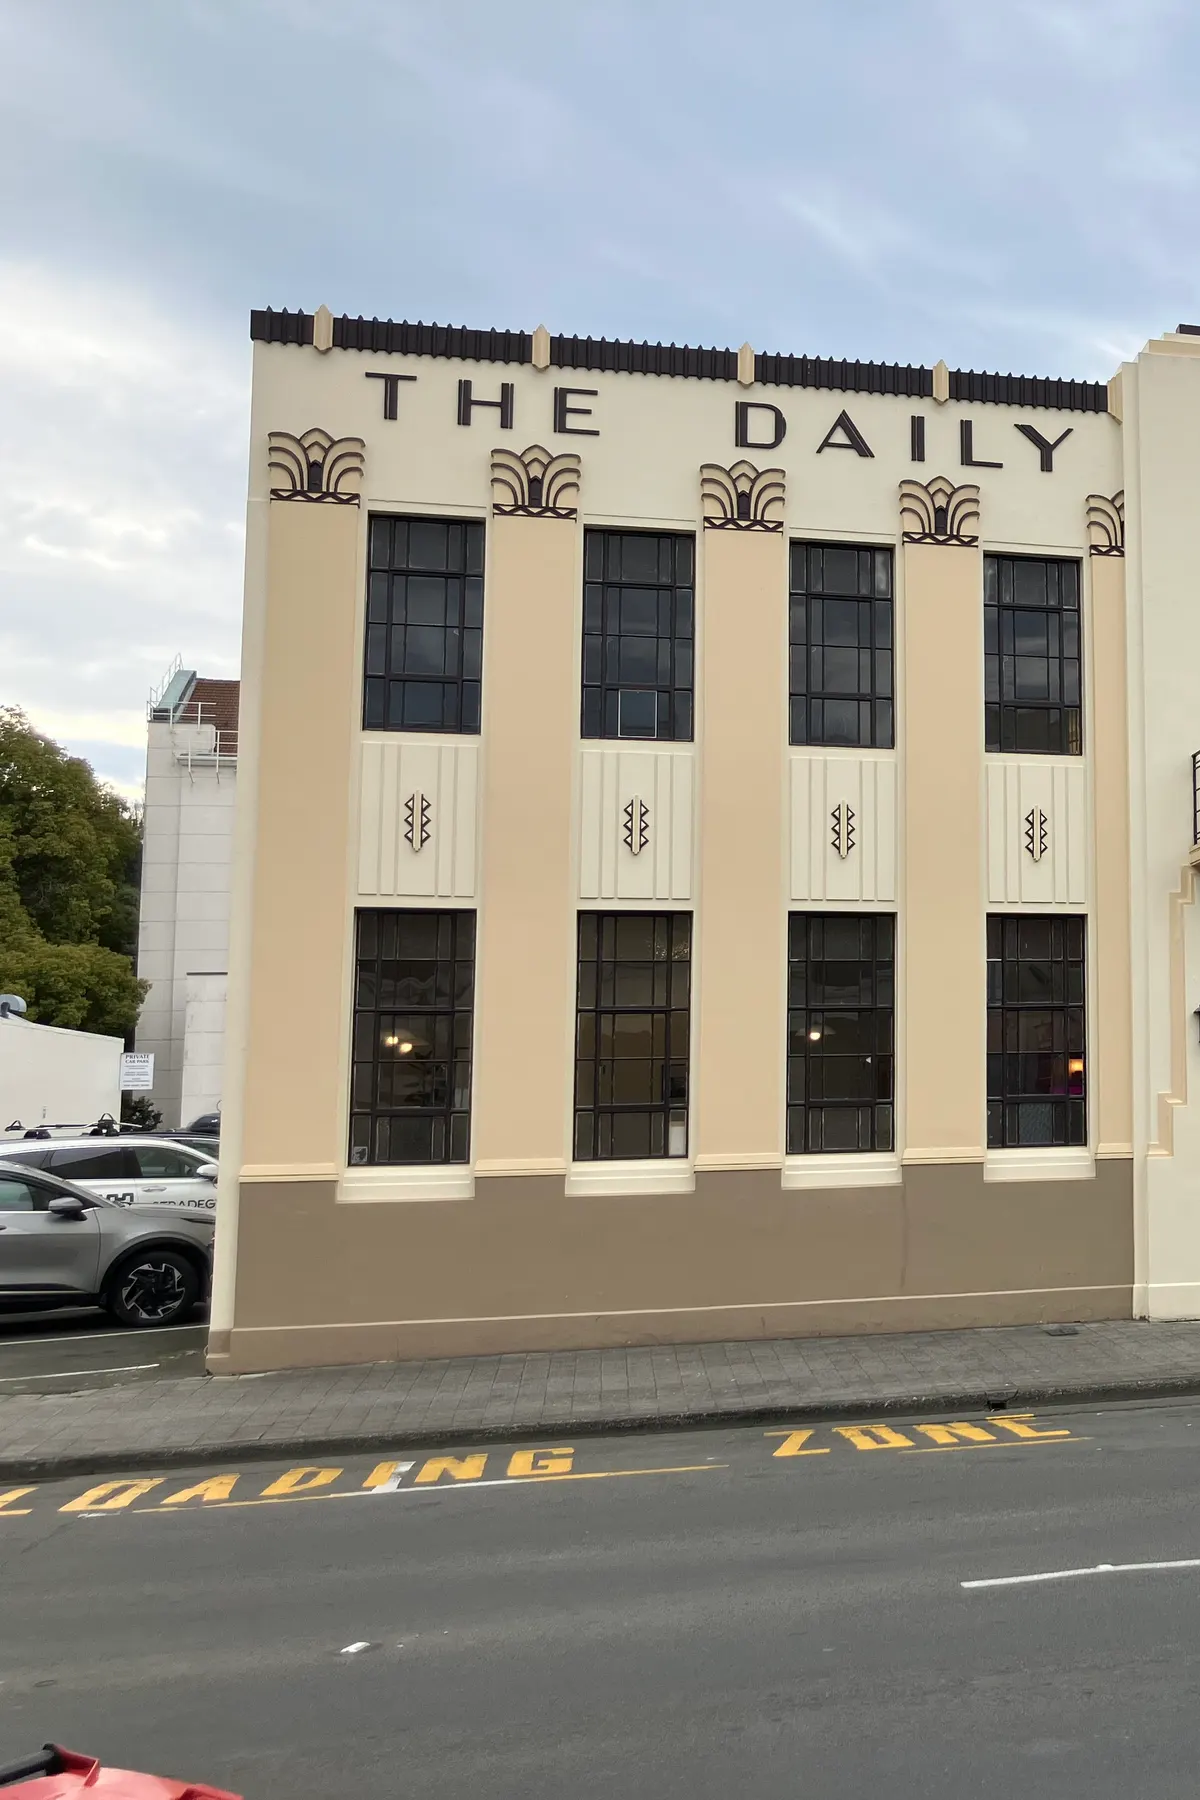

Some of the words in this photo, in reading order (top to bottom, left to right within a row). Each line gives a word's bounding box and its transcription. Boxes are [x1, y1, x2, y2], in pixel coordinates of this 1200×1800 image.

[365, 371, 600, 436] THE
[735, 400, 1074, 472] DAILY
[0, 1447, 575, 1516] LOADING
[763, 1413, 1071, 1457] ZONE
